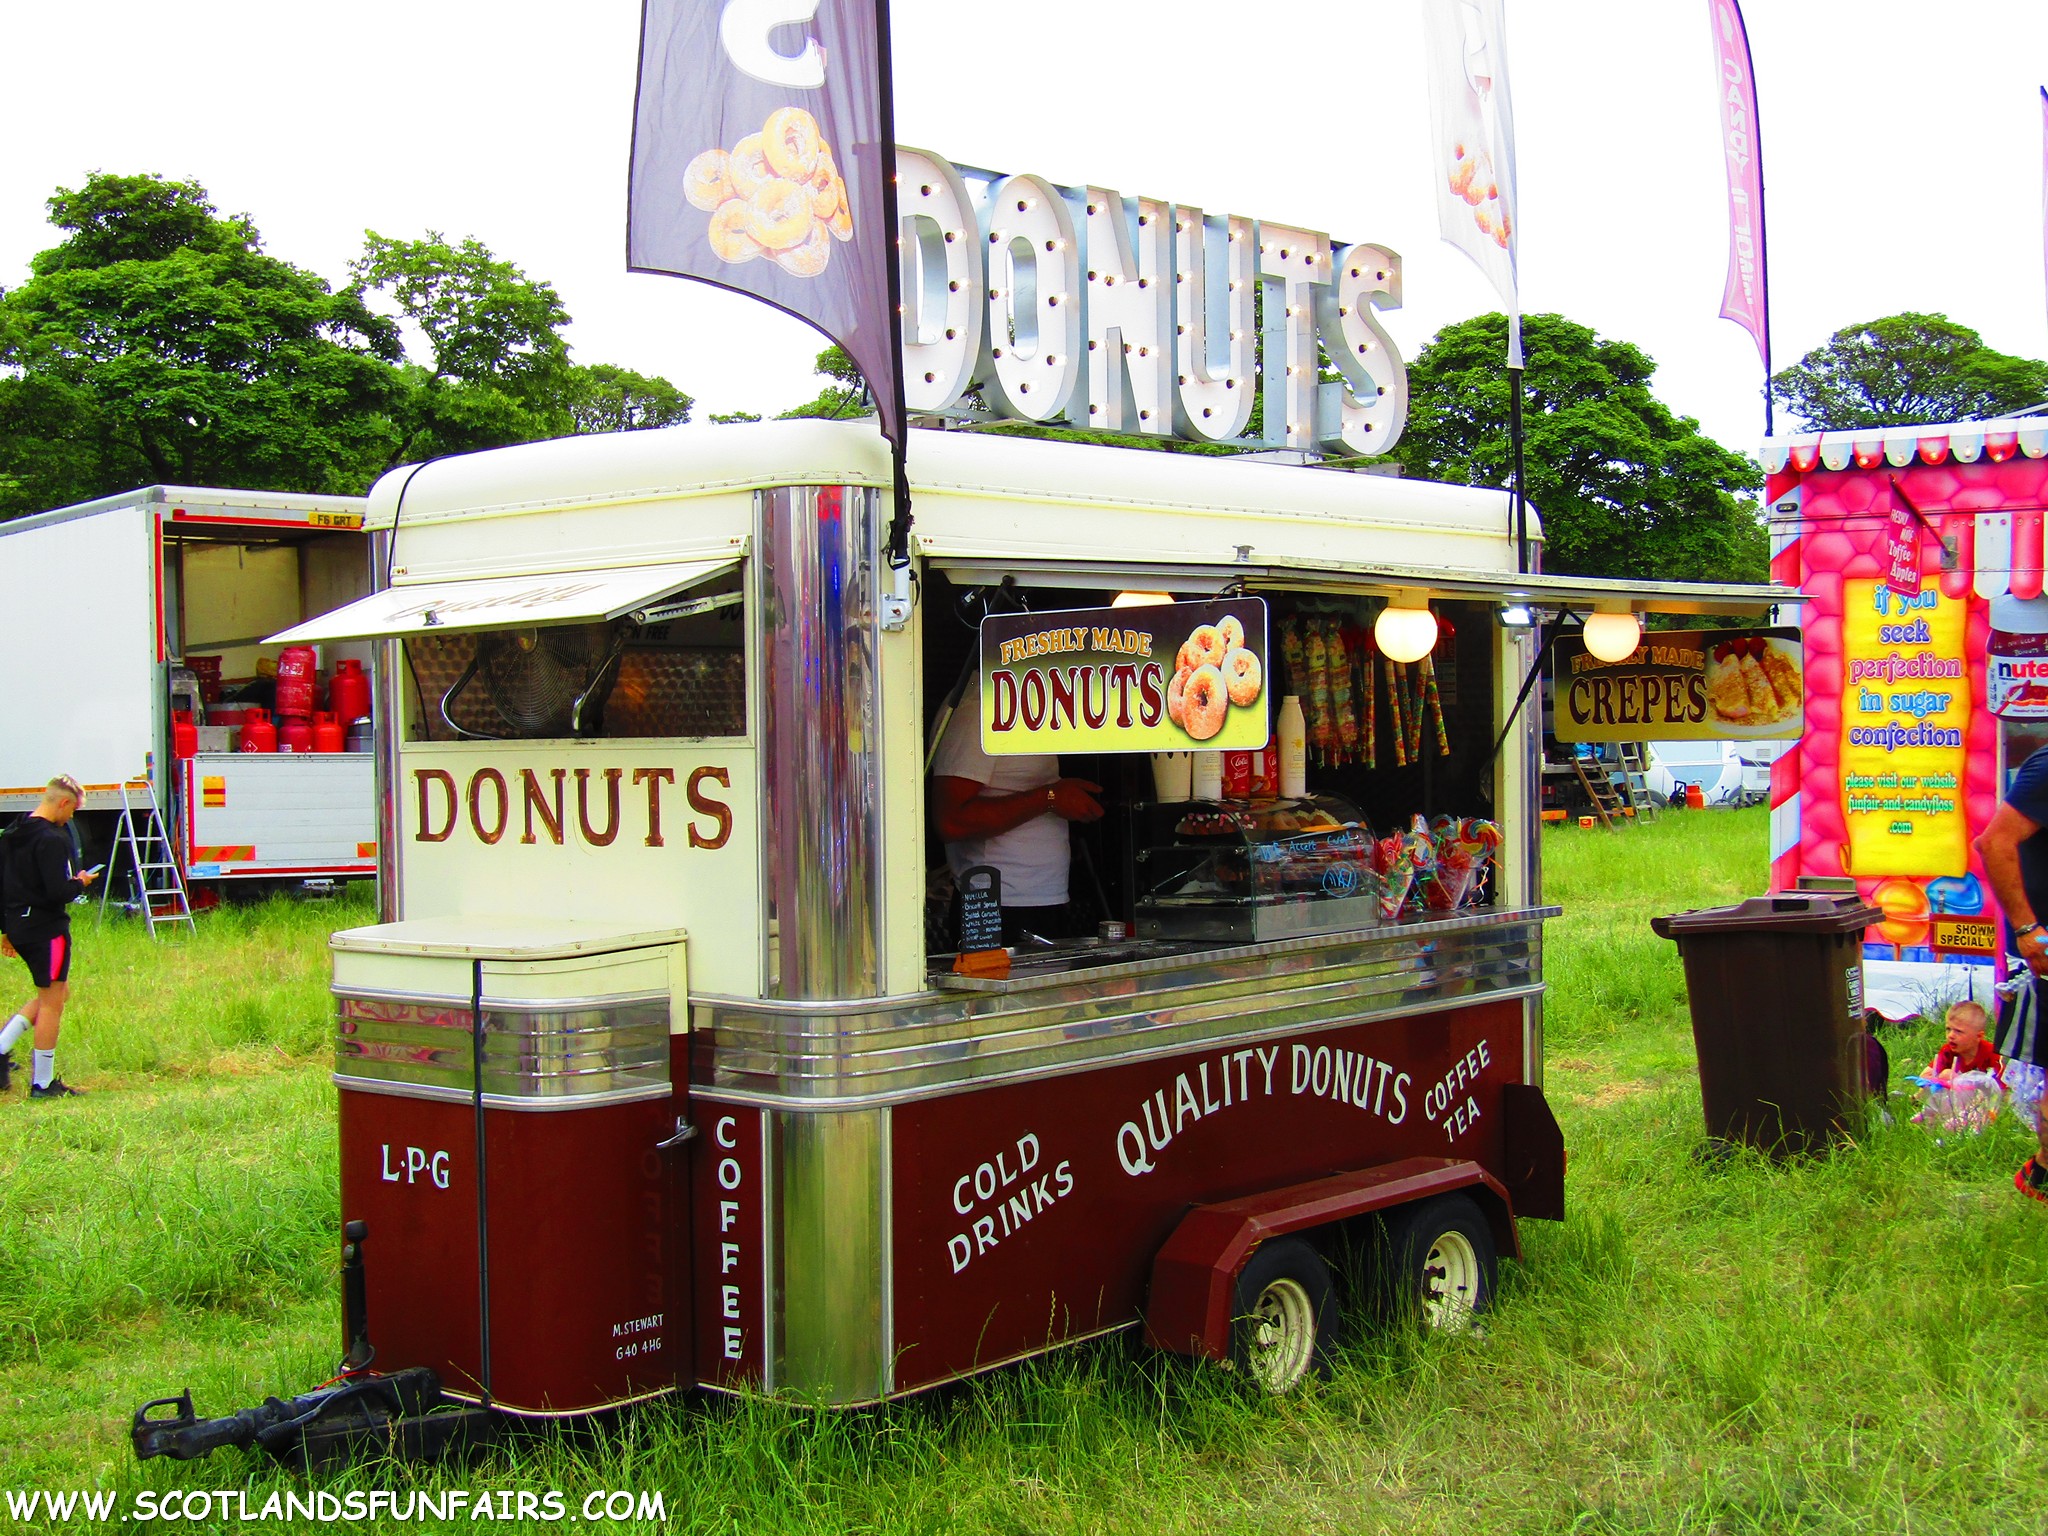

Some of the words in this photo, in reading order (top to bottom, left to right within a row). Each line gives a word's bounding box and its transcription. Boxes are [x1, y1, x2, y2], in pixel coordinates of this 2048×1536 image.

[895, 144, 1408, 456] DONUTS
[1889, 540, 1911, 561] Toffee
[1890, 561, 1917, 582] Apples
[1874, 585, 1890, 615] if
[1000, 627, 1088, 665] FRESHLY
[1091, 627, 1153, 657] MADE
[1880, 618, 1930, 643] seek
[1651, 646, 1704, 670] MADE
[1850, 653, 1961, 685] perfection
[991, 662, 1165, 732] DONUTS
[1569, 673, 1708, 725] CREPES
[1859, 688, 1882, 711] in
[1890, 691, 1950, 717] sugar
[1850, 721, 1961, 751] confection
[1845, 772, 1874, 791] please
[1877, 772, 1898, 788] visit
[1901, 776, 1917, 788] our
[1920, 772, 1957, 788] website
[413, 766, 733, 850] DONUTS
[1889, 821, 1912, 834] .com
[1940, 934, 1984, 947] SPECIAL
[1424, 1039, 1491, 1121] COFFEE
[1116, 1045, 1280, 1177] QUALITY
[1291, 1044, 1411, 1125] DONUTS
[1443, 1095, 1481, 1144] TEA
[953, 1132, 1040, 1215] COLD
[947, 1159, 1074, 1275] DRINKS
[716, 1116, 743, 1360] COFFEE
[616, 1343, 638, 1360] G40
[642, 1337, 661, 1354] 4HG
